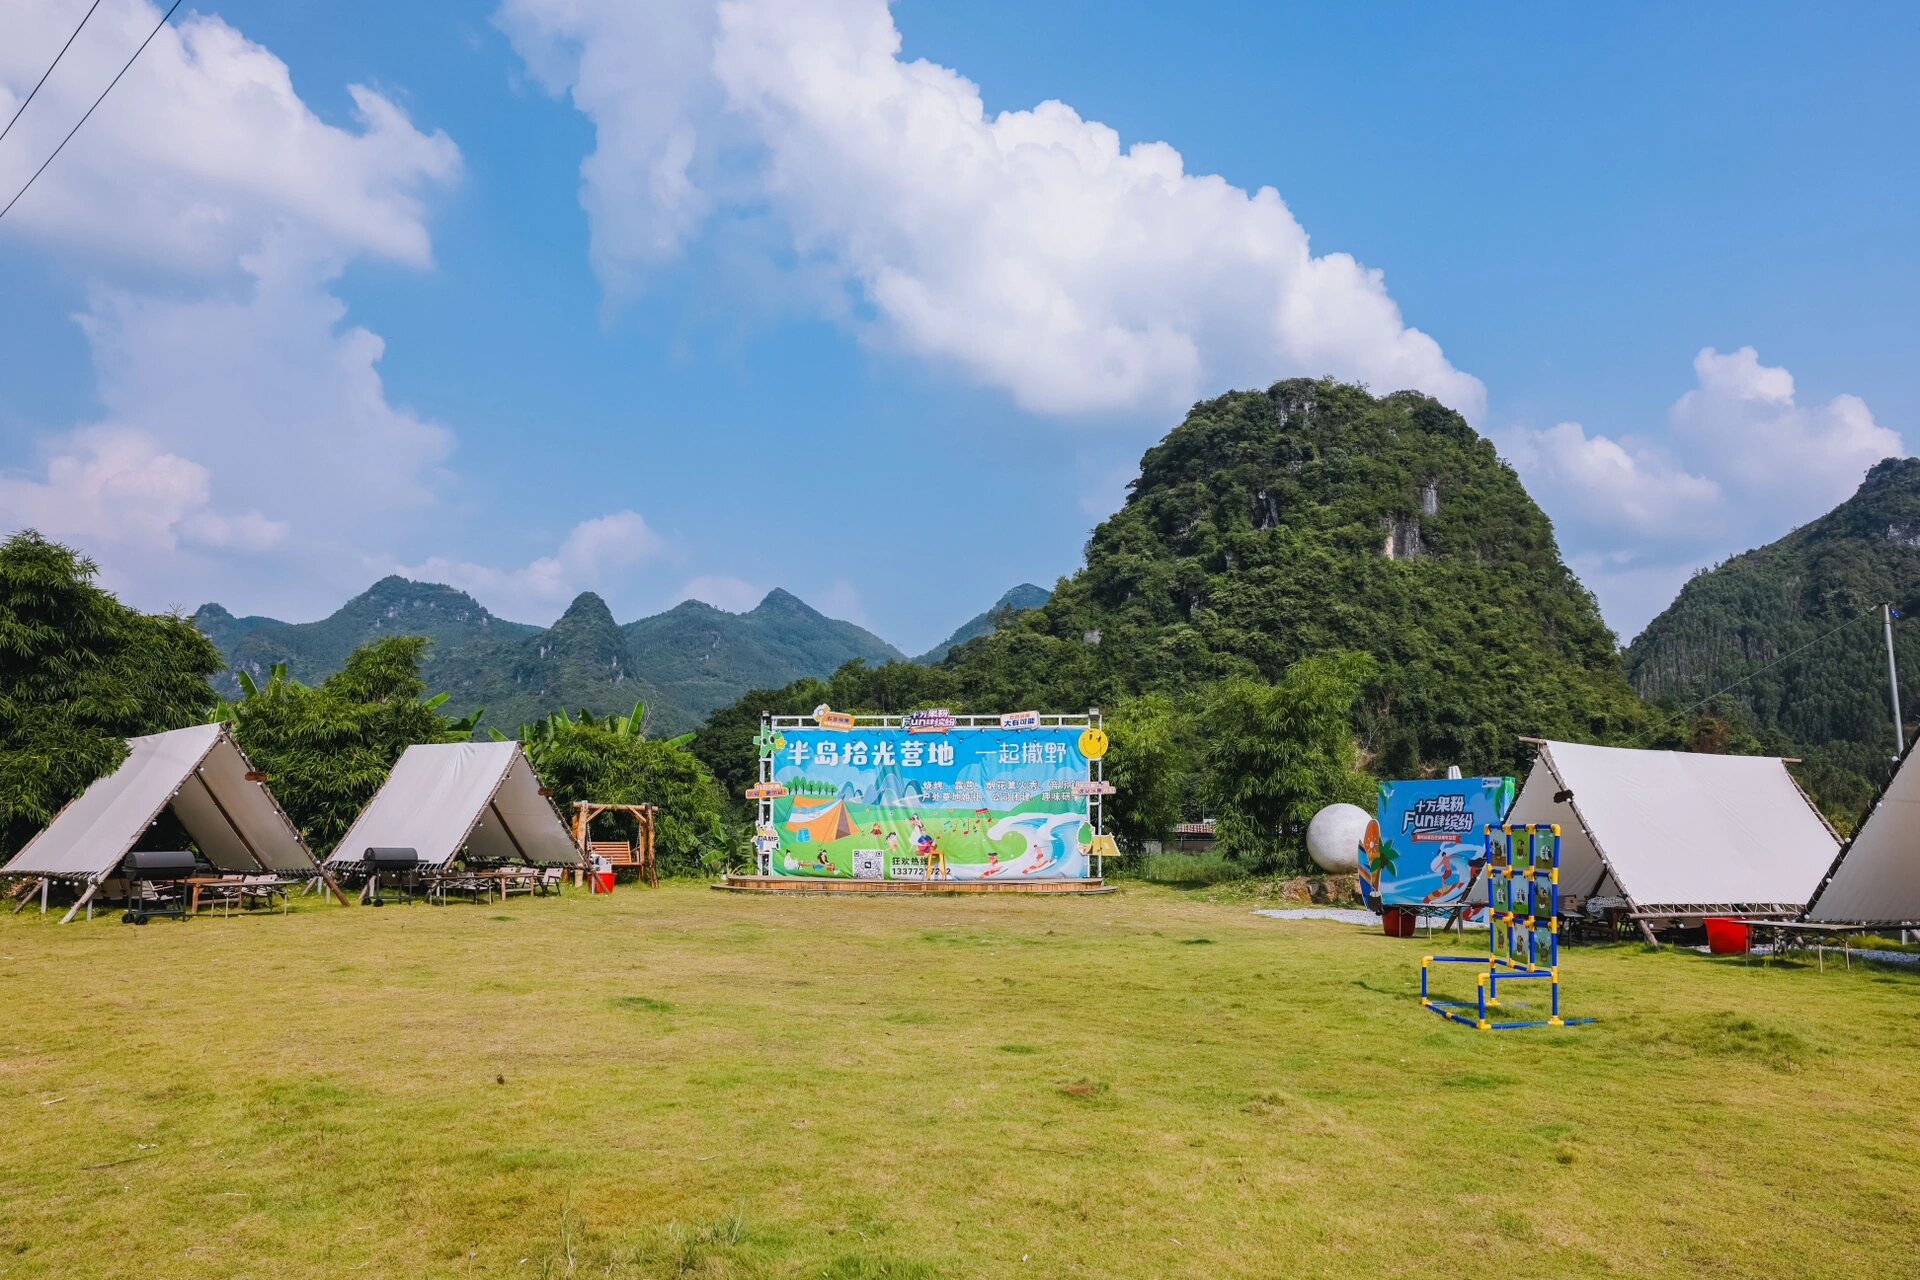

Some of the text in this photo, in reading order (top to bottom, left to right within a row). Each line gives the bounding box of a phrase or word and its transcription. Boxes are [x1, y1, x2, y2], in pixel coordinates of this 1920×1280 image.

[787, 741, 1067, 766] 半岛拾光营地 一起撒野
[1415, 796, 1465, 813] 十万果粉
